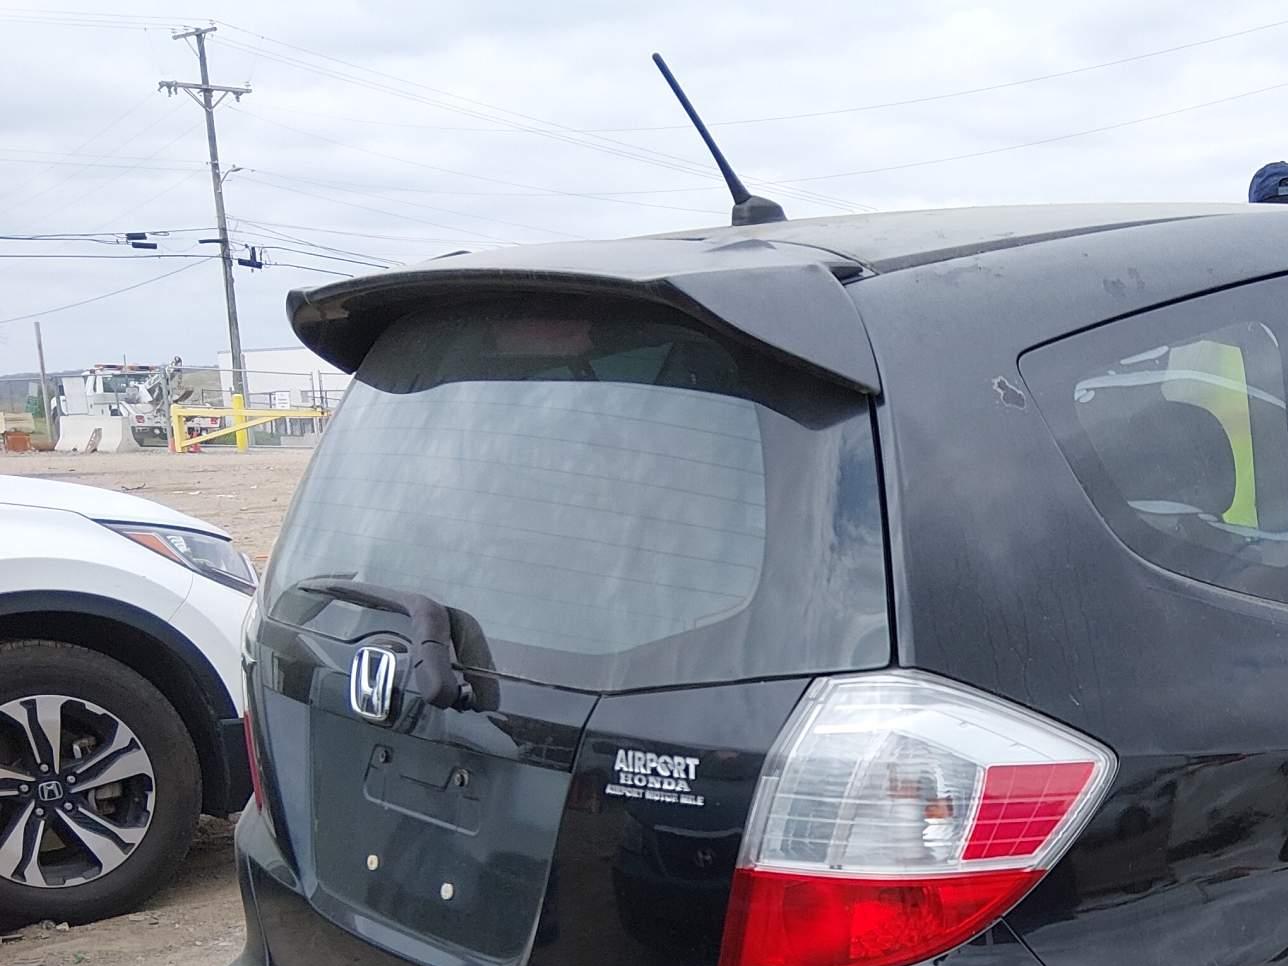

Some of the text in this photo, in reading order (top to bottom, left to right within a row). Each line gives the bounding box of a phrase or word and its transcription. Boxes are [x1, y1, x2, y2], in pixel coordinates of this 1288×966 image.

[614, 748, 700, 780] AIRPORT
[605, 783, 645, 798] AIRPORT
[619, 772, 691, 792] HONDA
